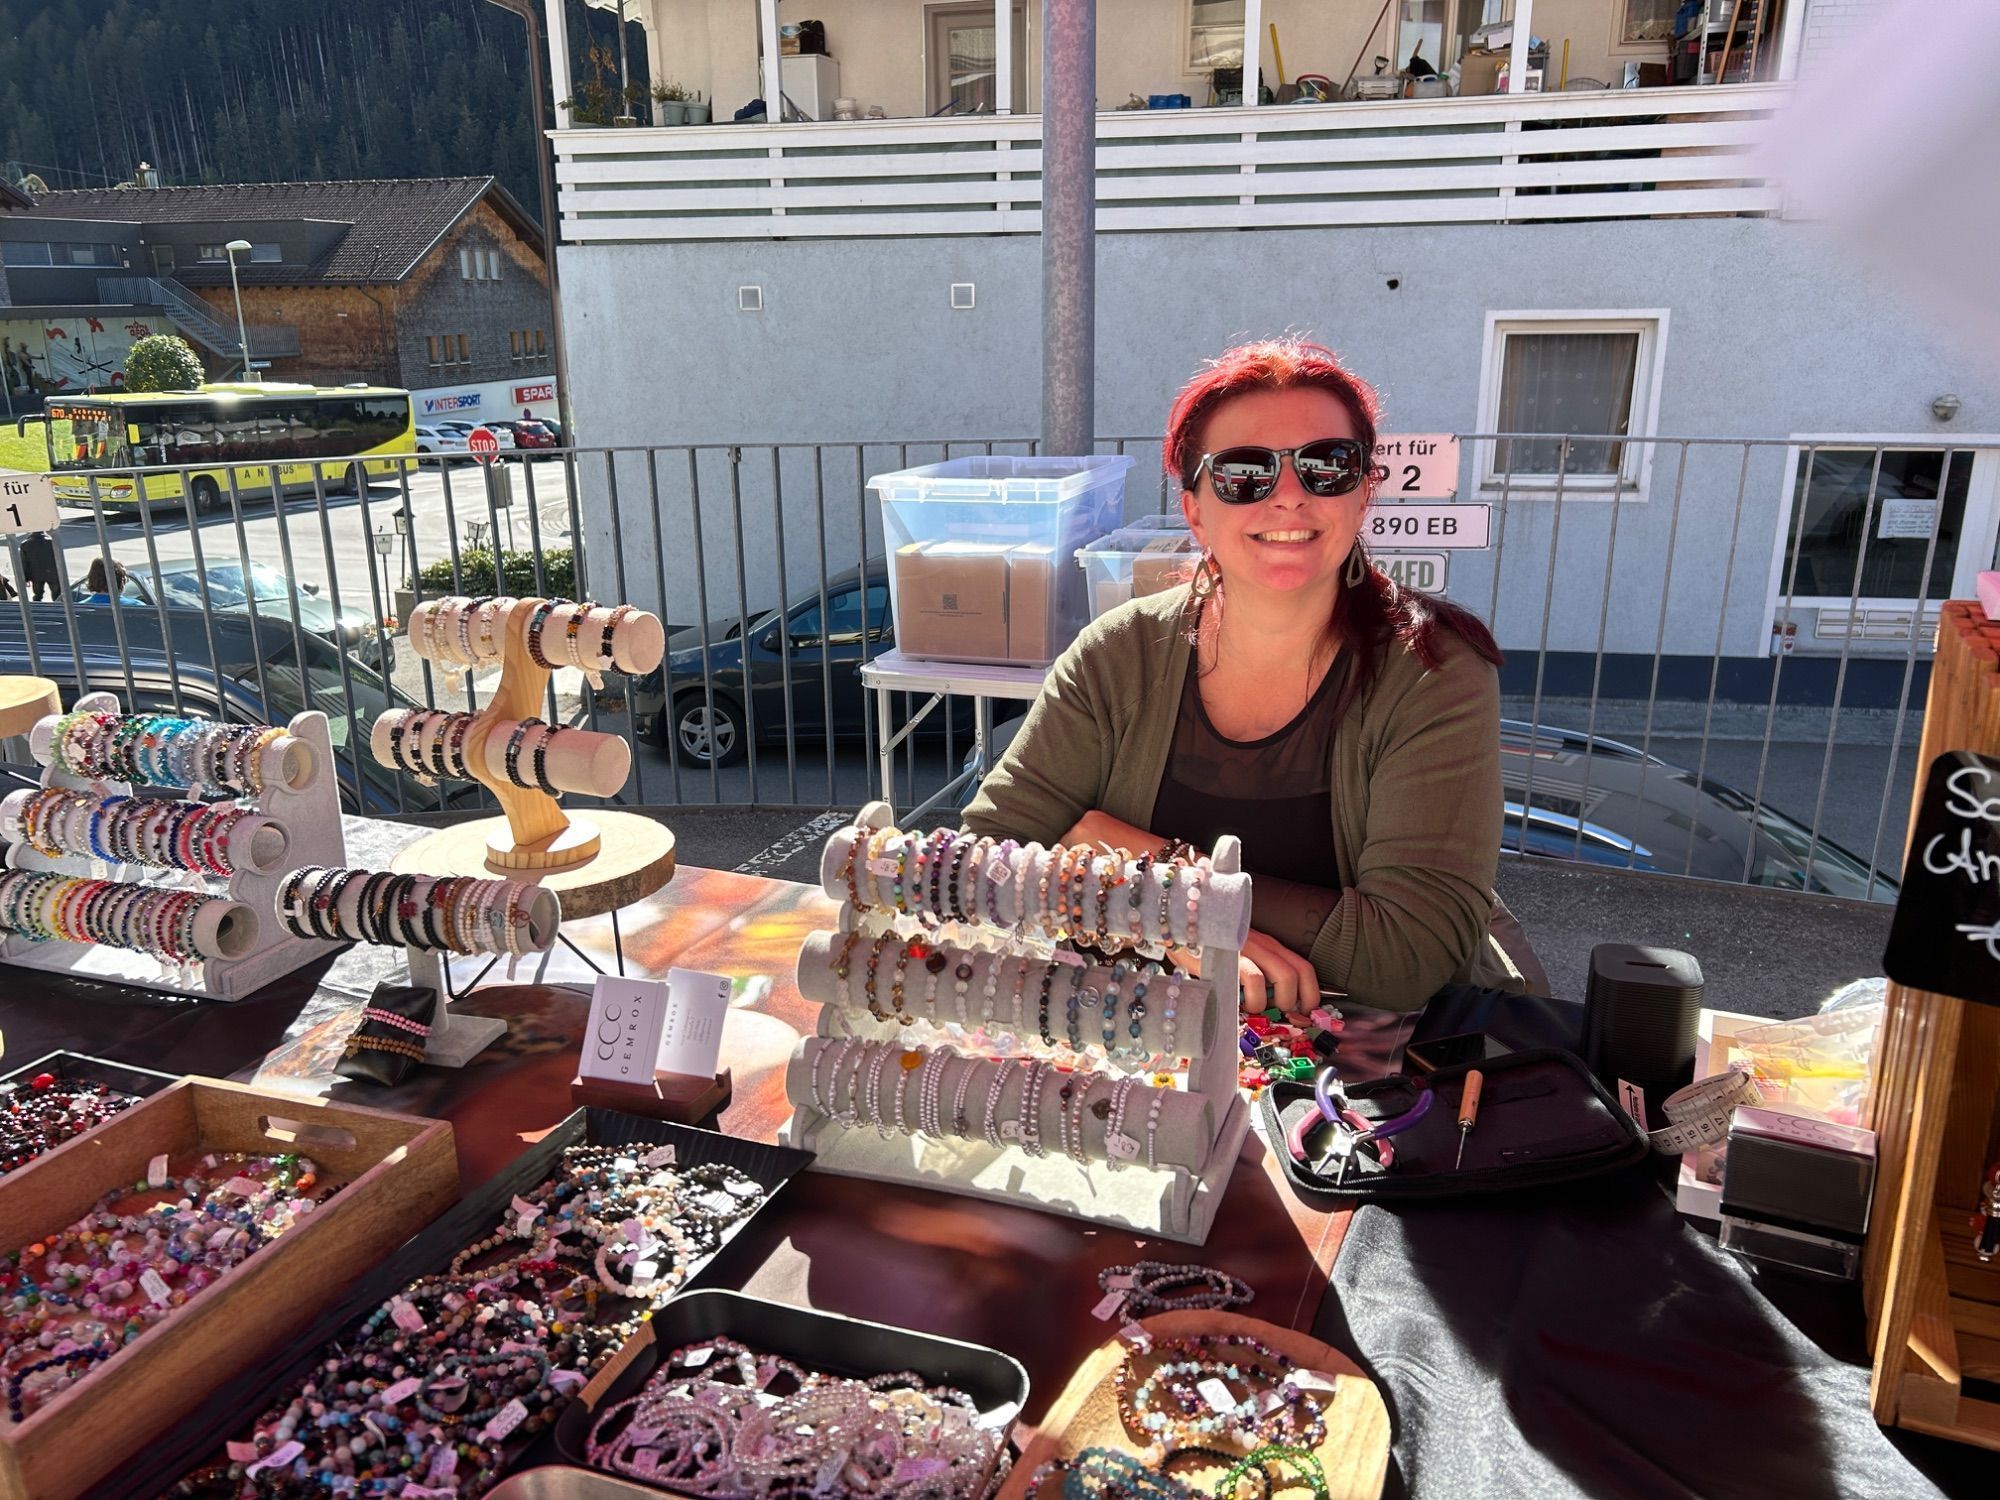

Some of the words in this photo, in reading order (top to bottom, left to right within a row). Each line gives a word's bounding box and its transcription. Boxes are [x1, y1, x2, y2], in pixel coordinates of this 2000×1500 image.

[433, 393, 480, 411] INTERSPORT
[522, 386, 553, 401] SPAR
[470, 440, 496, 452] STOP
[1375, 440, 1402, 456] ert
[1409, 440, 1437, 456] für
[1401, 465, 1421, 491] 2
[3, 481, 30, 496] für
[6, 503, 22, 527] 1
[1371, 517, 1419, 535] 890
[1427, 517, 1458, 536] EB
[620, 995, 642, 1075] GEMROX
